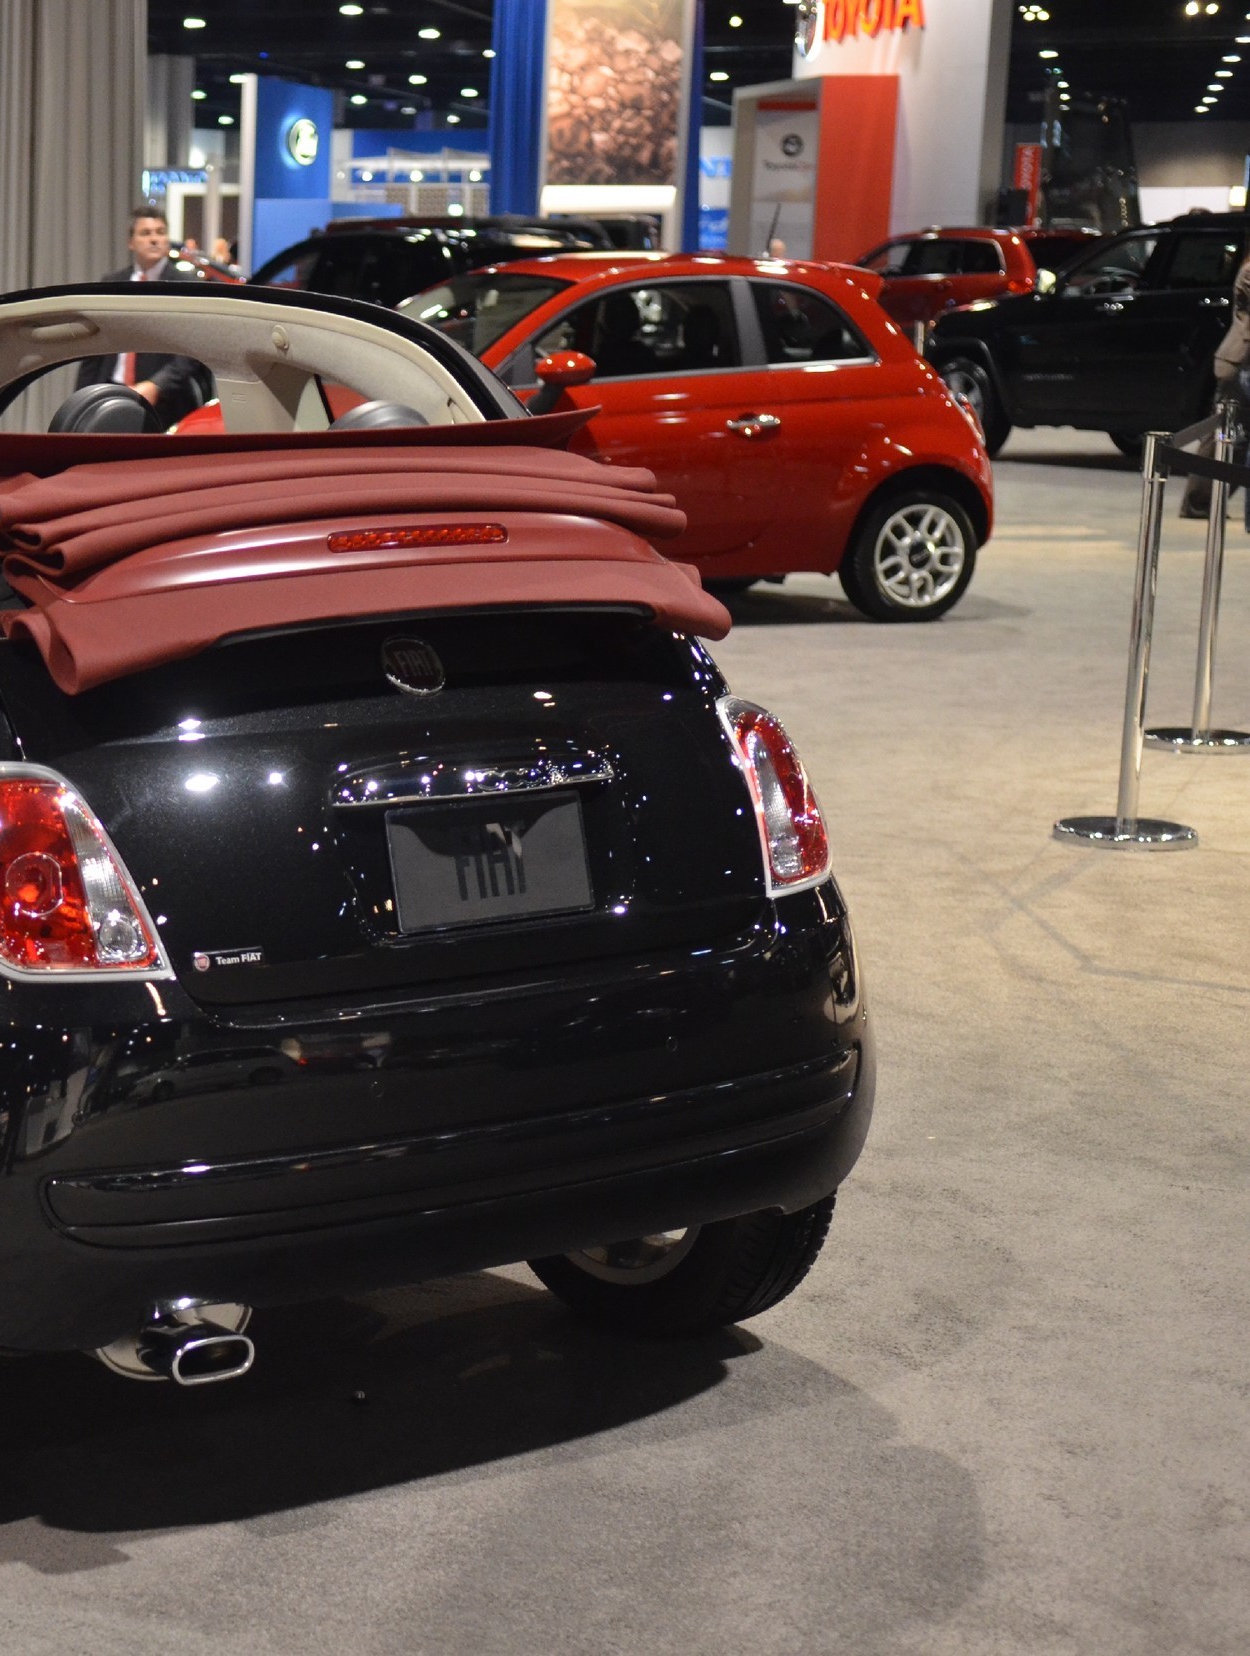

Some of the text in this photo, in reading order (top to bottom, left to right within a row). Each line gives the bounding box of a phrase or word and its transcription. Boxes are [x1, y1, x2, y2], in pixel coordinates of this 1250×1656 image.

[823, 0, 926, 42] TOYOTA
[392, 650, 434, 678] FIAT
[450, 819, 527, 902] FIAT
[215, 956, 240, 966] Team
[241, 952, 262, 963] FIAT
